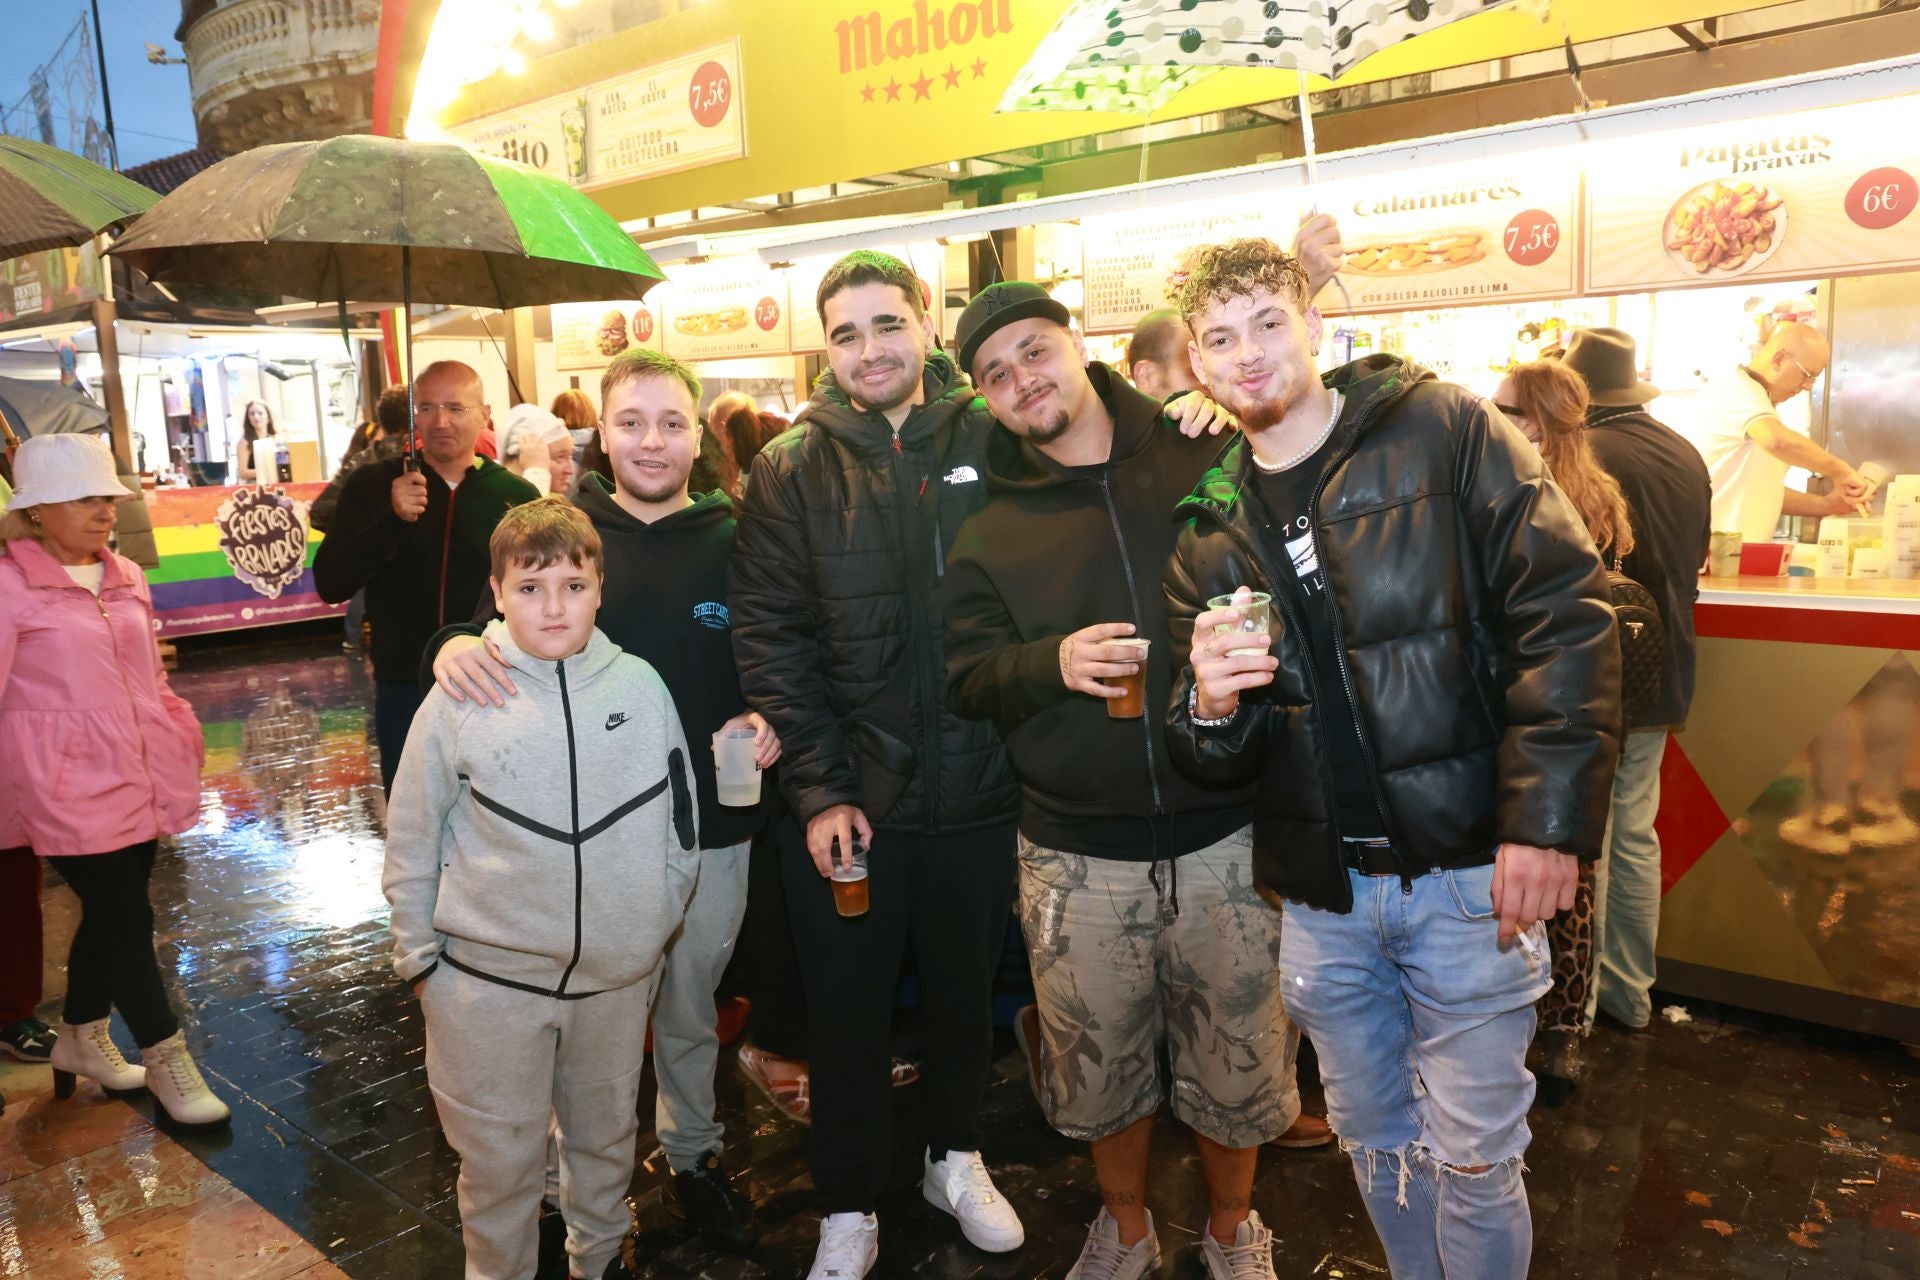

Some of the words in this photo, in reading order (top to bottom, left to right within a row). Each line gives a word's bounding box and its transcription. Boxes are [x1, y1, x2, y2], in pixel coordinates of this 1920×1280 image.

[691, 77, 727, 112] 7,5€
[621, 139, 679, 166] COCTELERA
[1679, 133, 1832, 167] Patatas
[1731, 150, 1831, 174] bravas
[1353, 184, 1522, 217] Calamares
[1863, 183, 1899, 214] 6€
[1506, 222, 1558, 256] 7,5€
[1362, 293, 1382, 303] CON
[1386, 289, 1418, 301] SALSA
[1422, 286, 1459, 298] ALIOLI
[1463, 285, 1476, 295] DE
[1480, 282, 1509, 294] LIMA
[693, 601, 716, 619] STREET
[608, 711, 625, 723] NIKE
